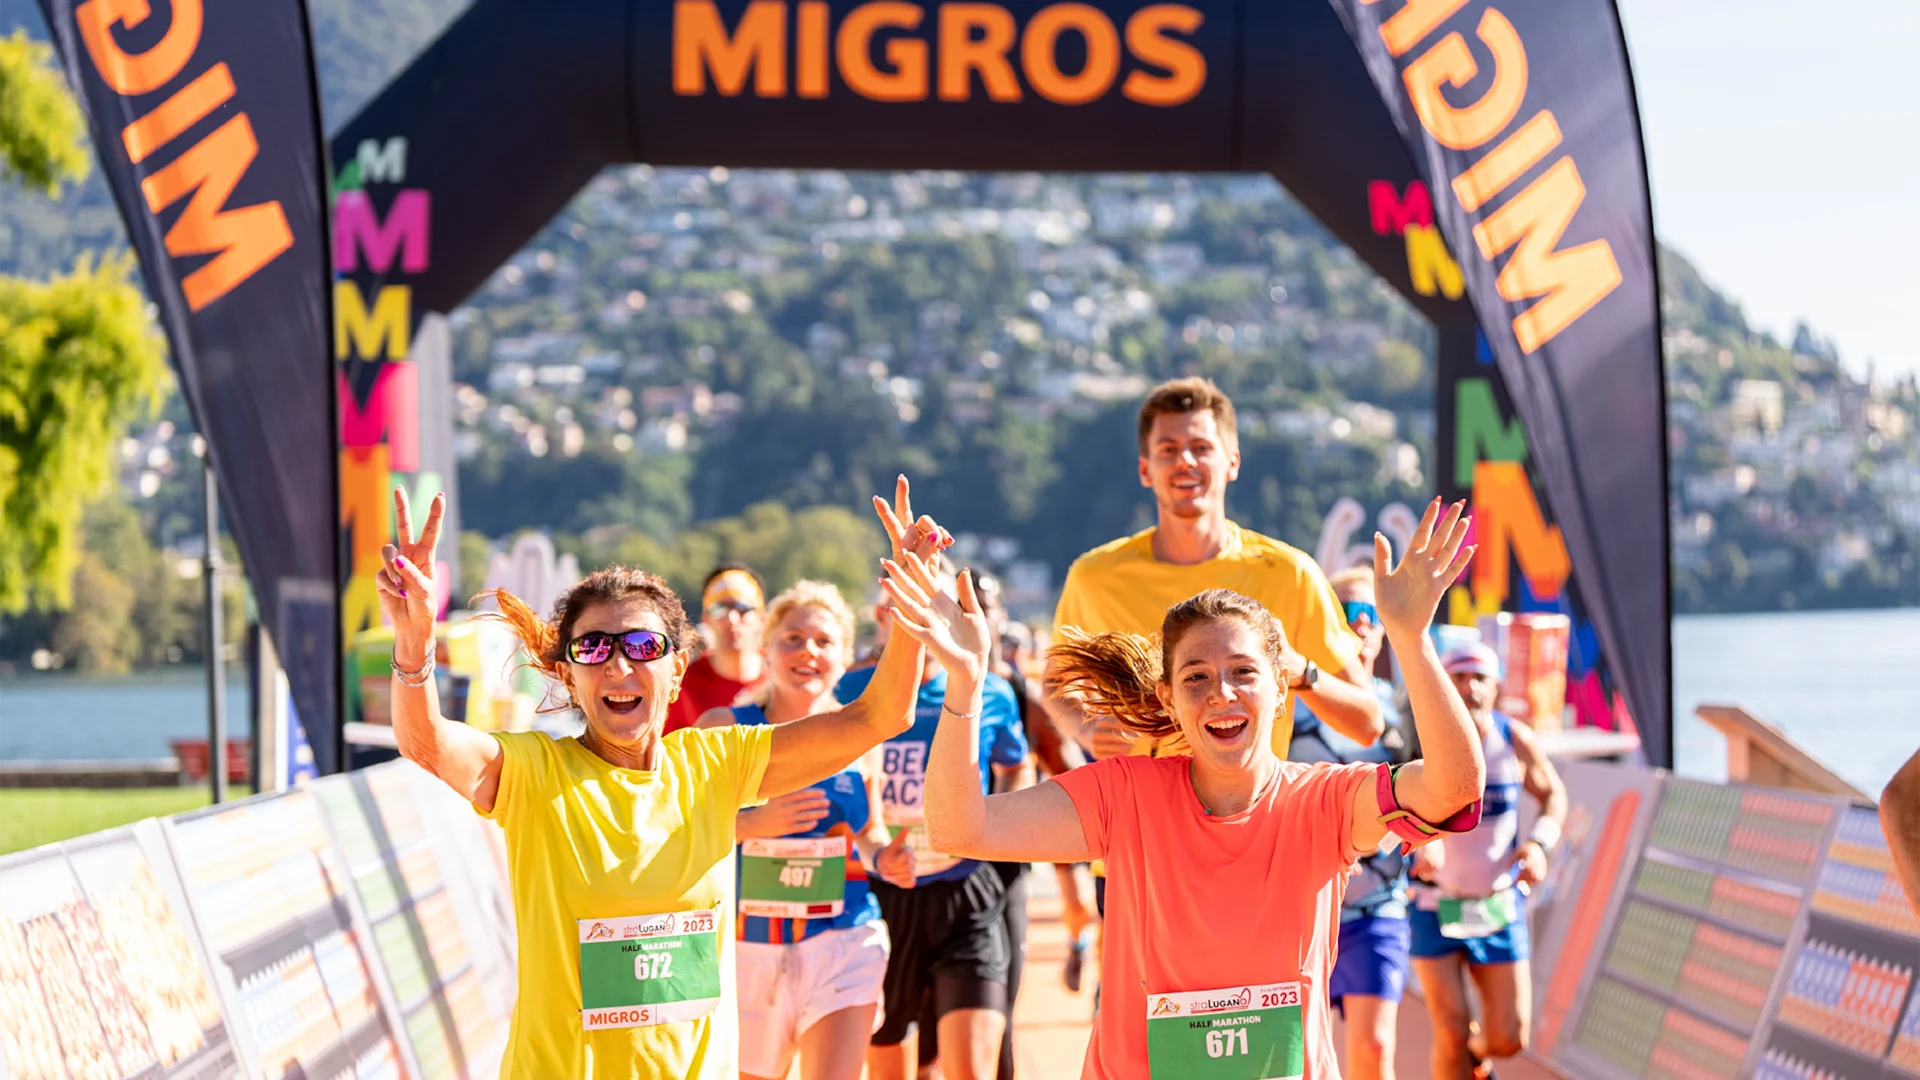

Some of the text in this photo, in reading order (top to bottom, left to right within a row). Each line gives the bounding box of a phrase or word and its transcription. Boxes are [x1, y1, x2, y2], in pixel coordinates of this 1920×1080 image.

[673, 0, 1207, 106] MIGROS
[334, 189, 431, 273] M
[335, 284, 411, 361] M
[779, 866, 814, 888] 497
[683, 919, 713, 932] 2023
[634, 952, 672, 980] 672
[1261, 991, 1298, 1007] 2023
[589, 1009, 649, 1026] MIGROS
[1205, 1027, 1249, 1059] 671
